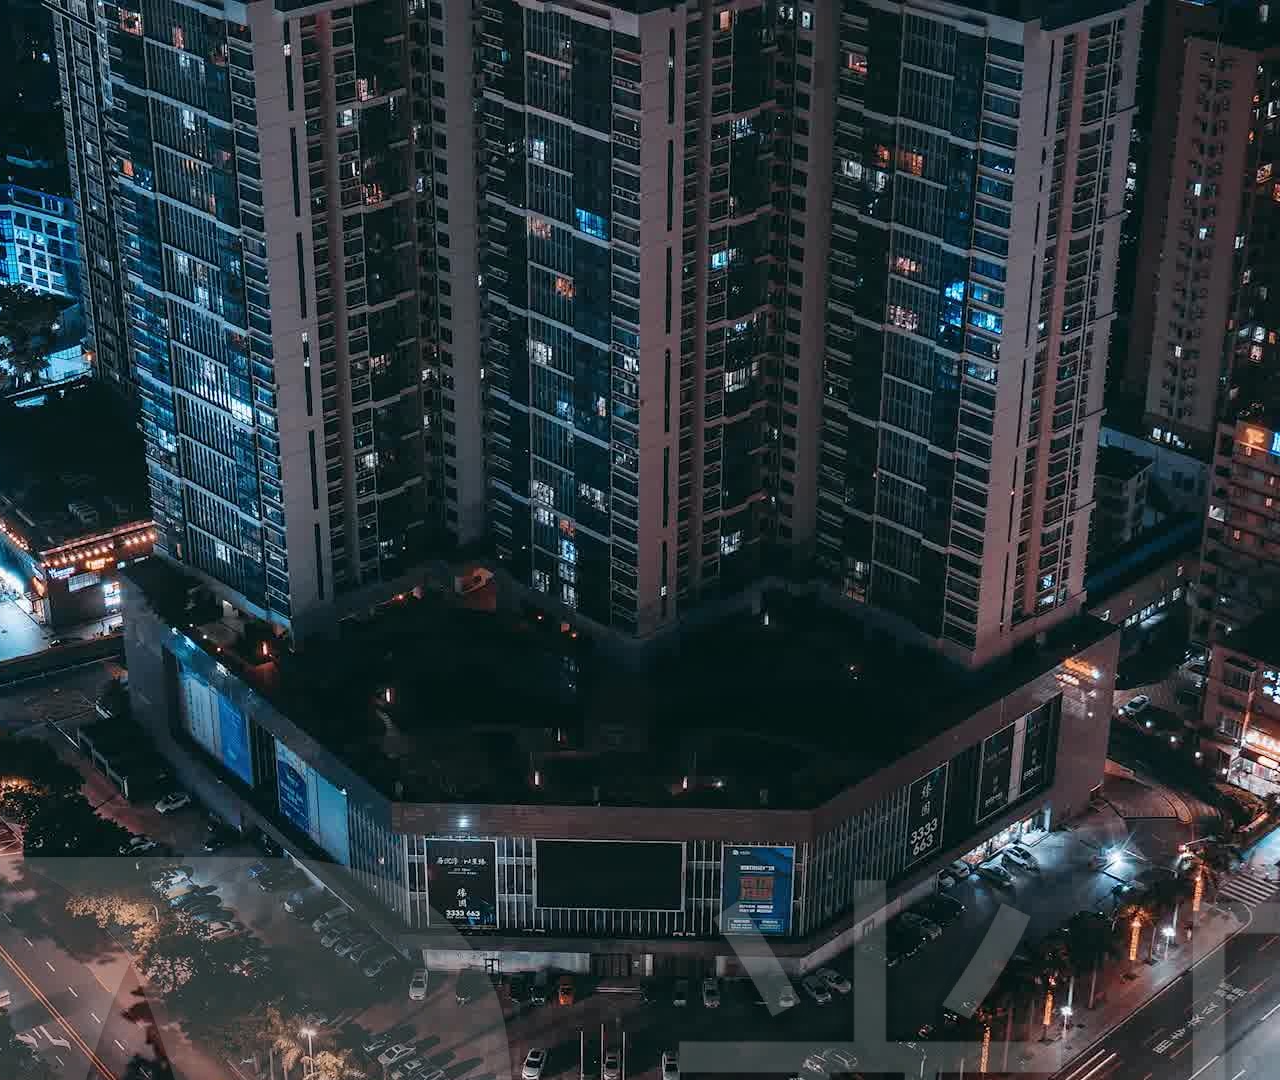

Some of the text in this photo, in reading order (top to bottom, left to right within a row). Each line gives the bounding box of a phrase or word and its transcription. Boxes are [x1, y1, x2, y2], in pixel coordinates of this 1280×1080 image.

[910, 817, 938, 846] 3333
[913, 835, 933, 857] 663
[445, 909, 465, 917] 3333
